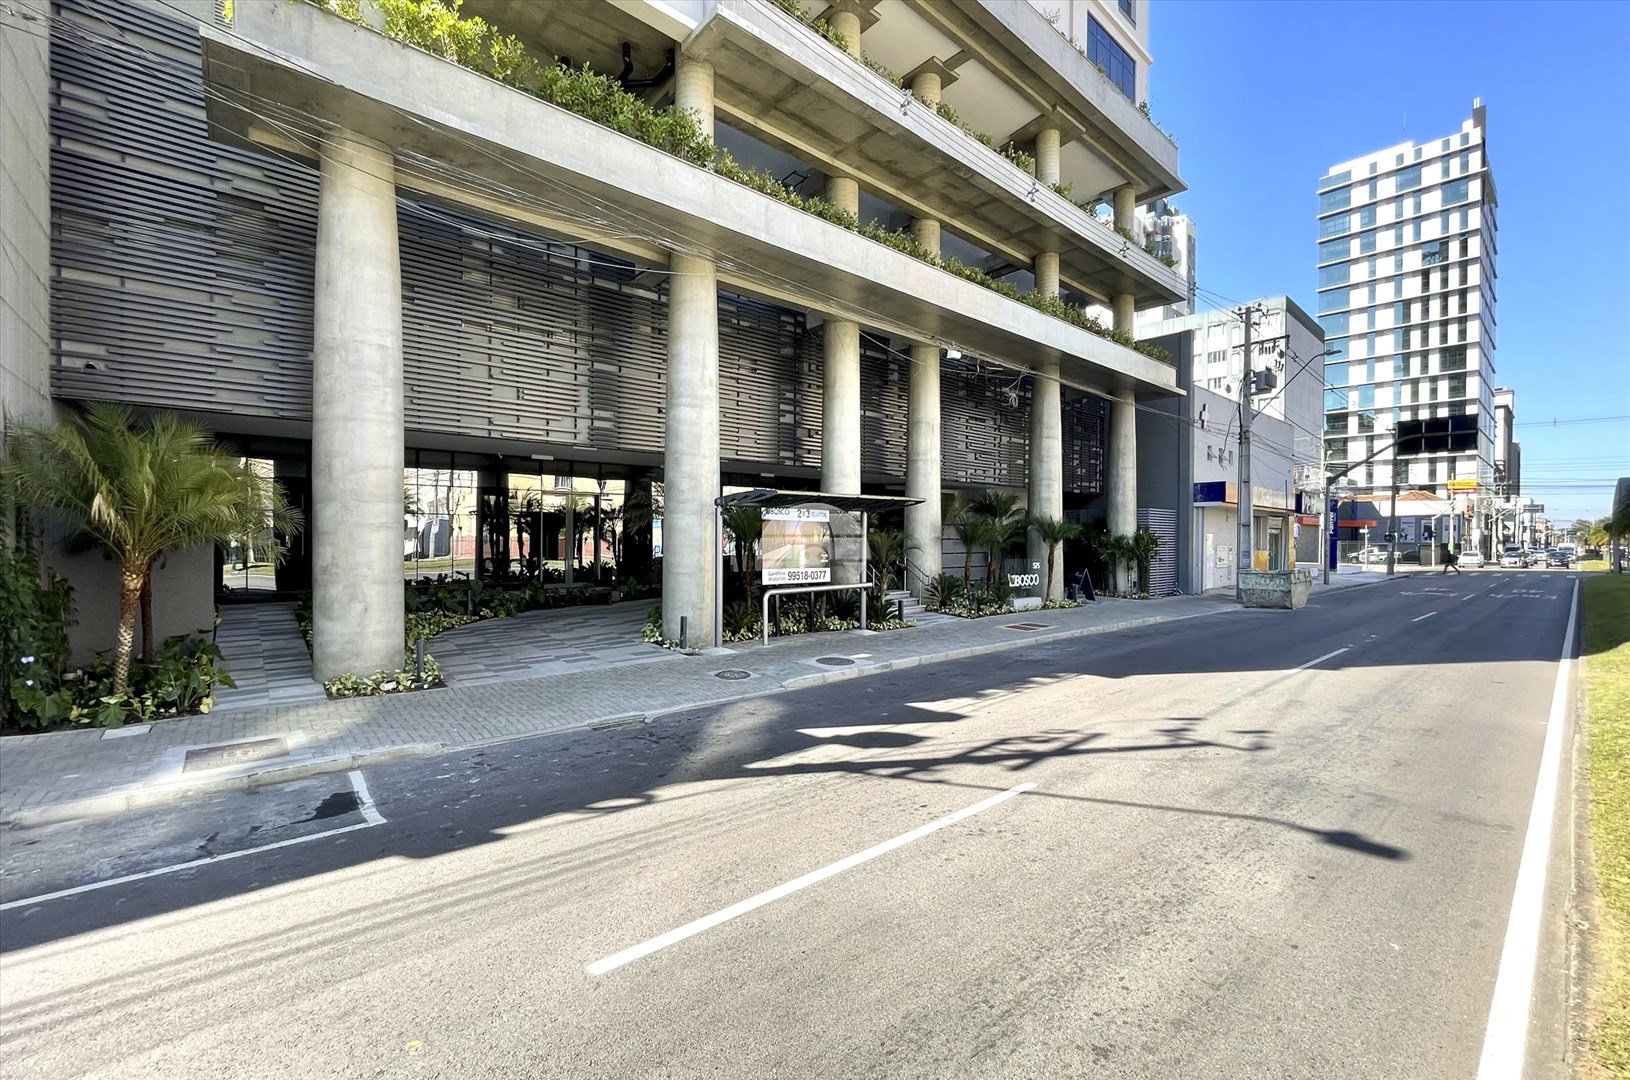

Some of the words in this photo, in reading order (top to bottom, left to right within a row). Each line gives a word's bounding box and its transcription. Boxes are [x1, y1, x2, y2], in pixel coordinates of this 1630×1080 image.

[796, 509, 802, 518] 2
[806, 509, 811, 518] 3
[787, 570, 826, 581] 99518-0377
[1015, 573, 1039, 586] BOSCO
